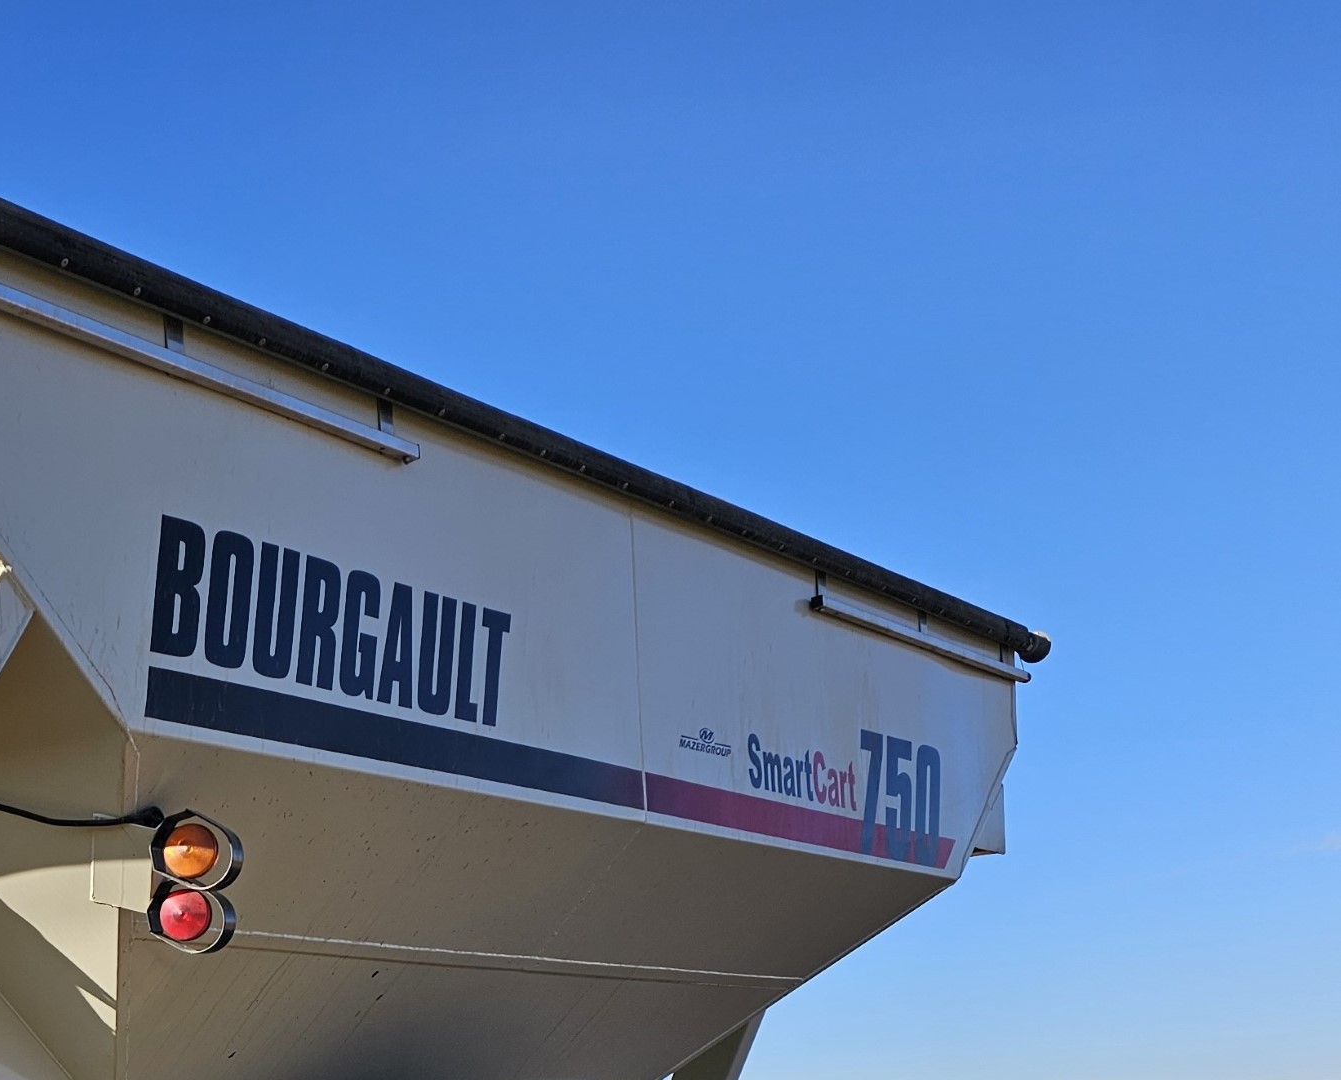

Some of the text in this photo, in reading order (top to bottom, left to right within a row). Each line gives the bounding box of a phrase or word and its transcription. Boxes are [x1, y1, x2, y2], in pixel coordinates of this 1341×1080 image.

[150, 514, 511, 727] BOURGAULT
[679, 738, 732, 758] MAZERGROUP
[748, 728, 941, 867] SmartCart 750
